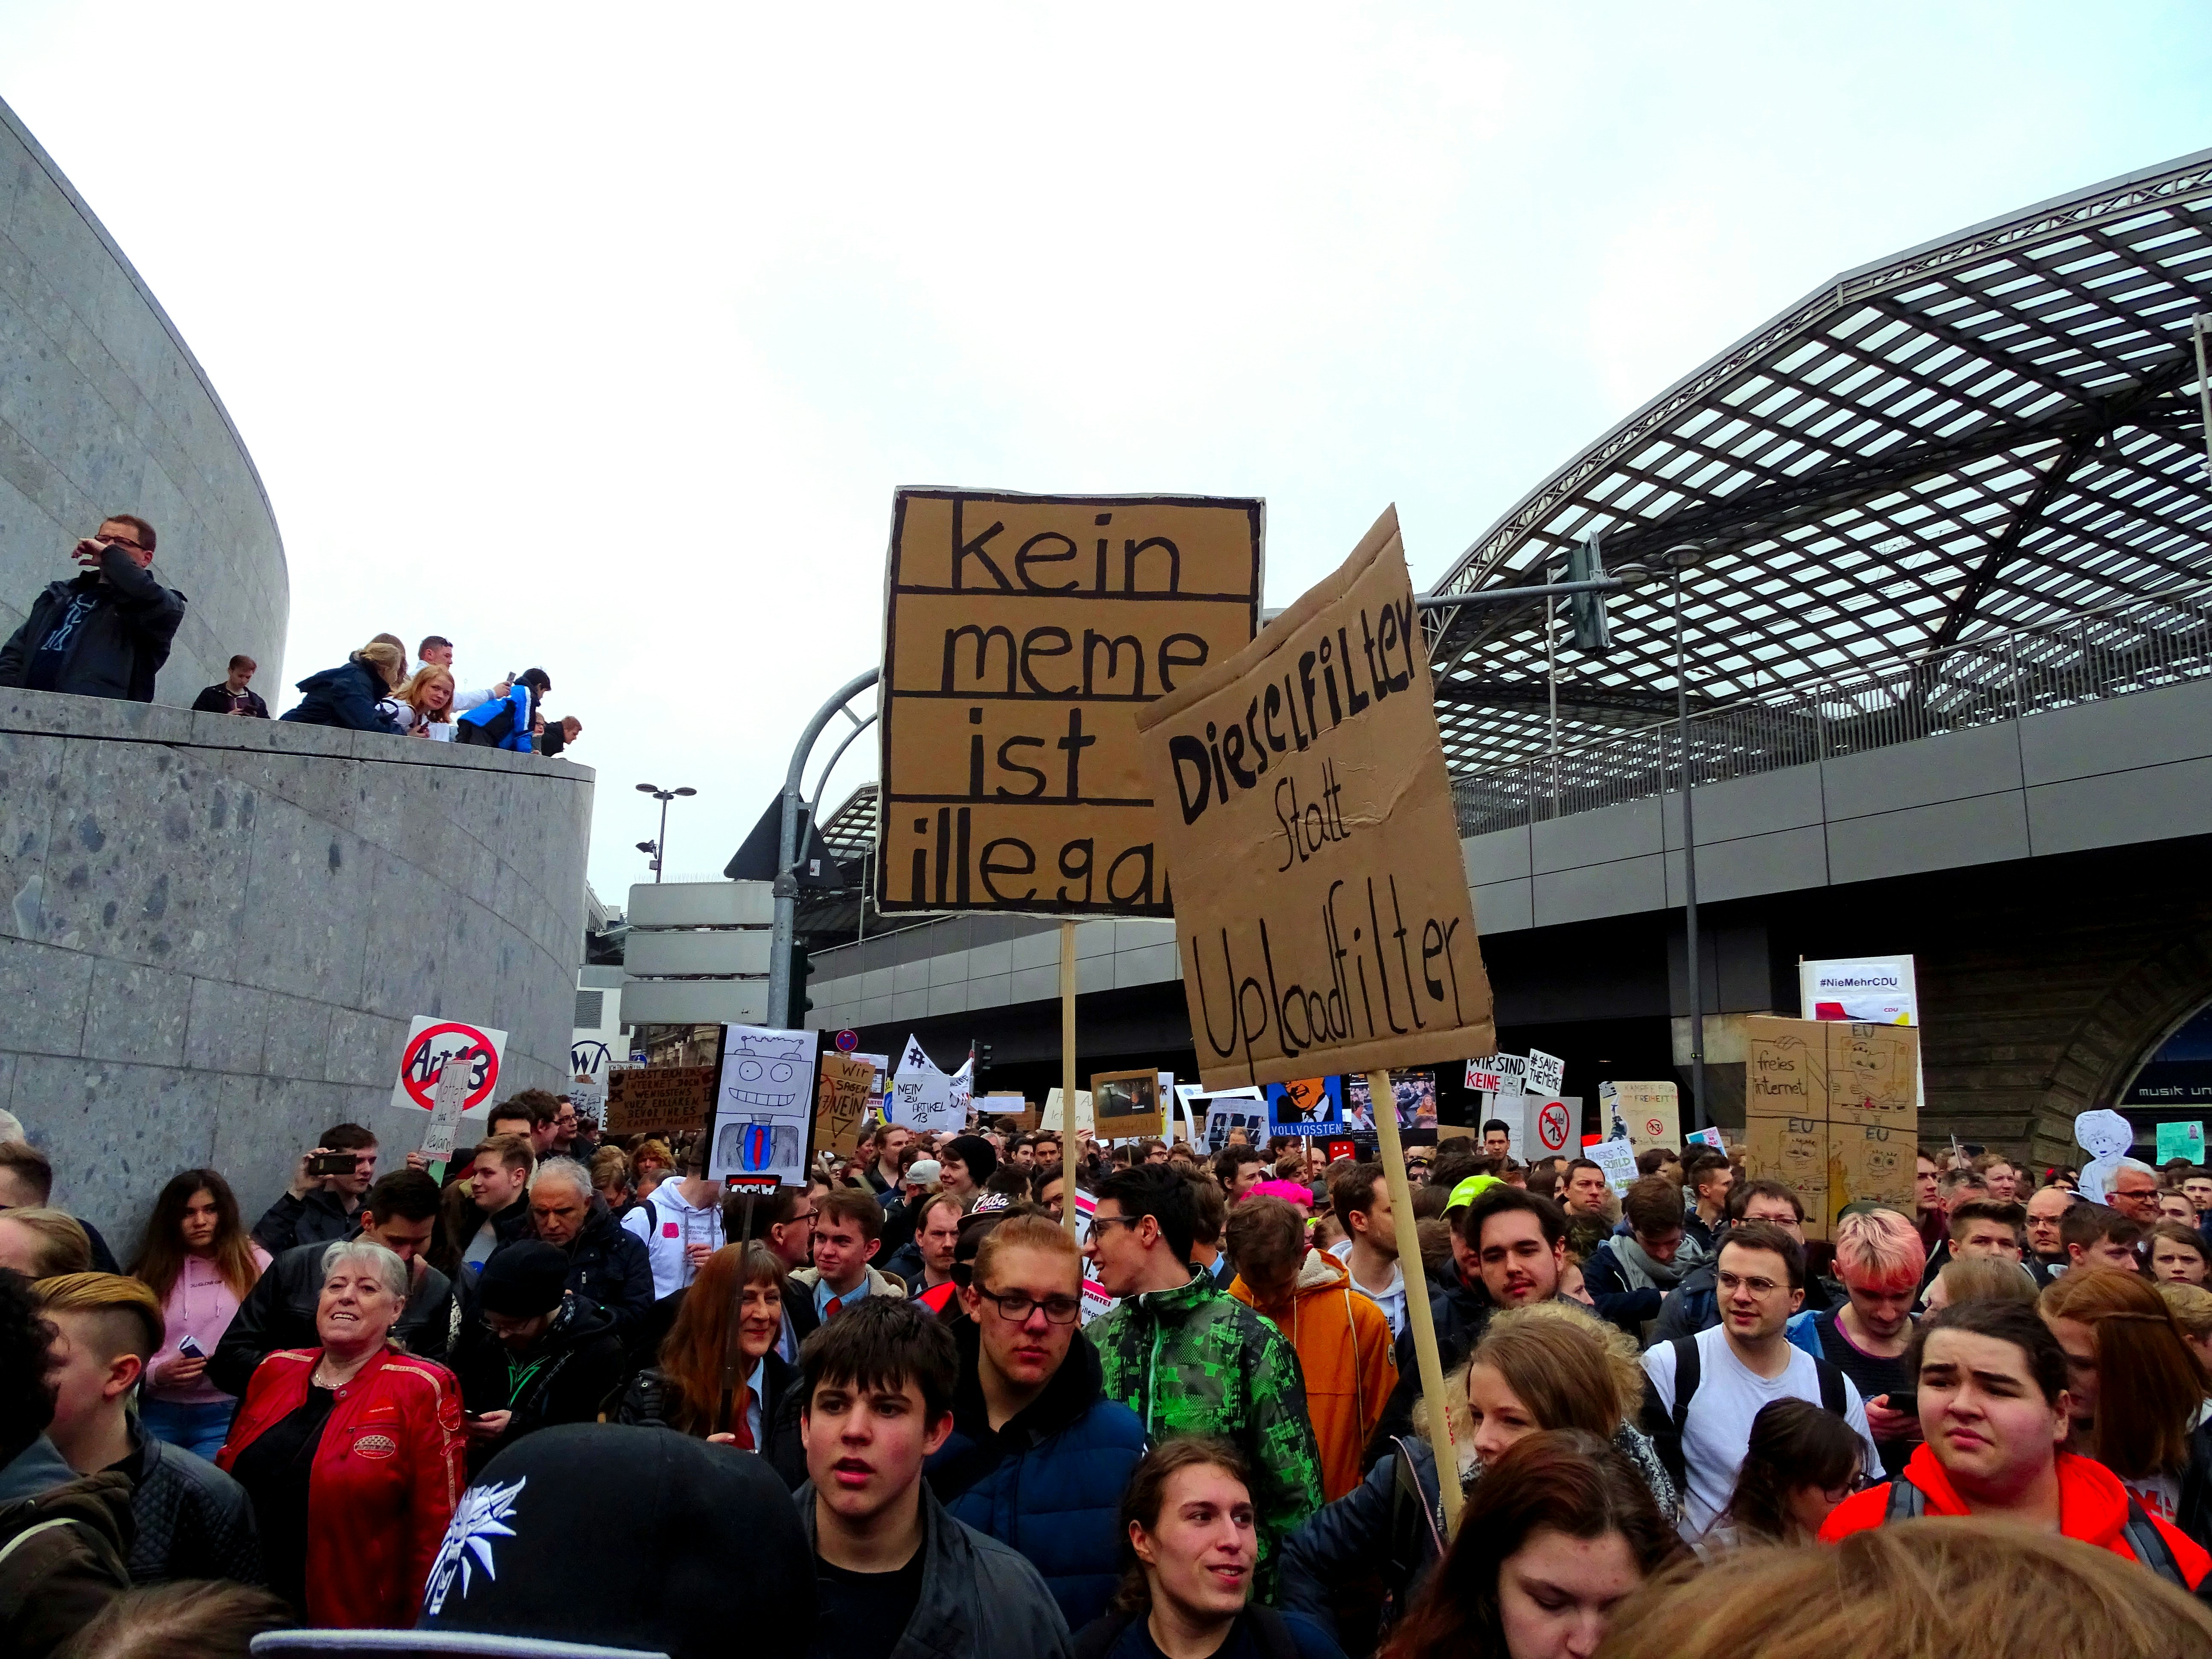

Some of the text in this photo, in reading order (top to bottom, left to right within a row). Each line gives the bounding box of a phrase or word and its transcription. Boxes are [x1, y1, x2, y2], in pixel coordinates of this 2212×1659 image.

[952, 498, 1179, 592] kein
[941, 625, 1208, 696] meme
[969, 708, 1096, 798] ist
[912, 807, 1173, 906] illega
[1193, 874, 1459, 1084] Uploadfilter
[1820, 977, 1898, 987] #NieMehrCDU
[1852, 1024, 1874, 1038] EU
[1470, 1056, 1525, 1076] WIR SIND
[1757, 1050, 1795, 1071] freies
[628, 1069, 661, 1080] LASST
[684, 1068, 702, 1077] DAS
[1467, 1070, 1501, 1091] KEINE
[626, 1078, 699, 1090] INTERNET DOCH
[836, 1080, 868, 1094] SAGEN
[898, 1083, 923, 1096] NEIN
[1755, 1076, 1806, 1095] internet
[2139, 1086, 2184, 1096] musik
[635, 1087, 692, 1099] WENIGSTENS
[663, 1108, 679, 1117] IHR
[683, 1106, 696, 1115] ES
[913, 1102, 946, 1113] ARTIKEL
[627, 1118, 662, 1128] KAPUTT
[912, 1112, 928, 1123] 13
[1271, 1123, 1342, 1136] VOLLVOSSTEN
[1789, 1119, 1814, 1133] EU
[1866, 1127, 1889, 1141] EU
[972, 1193, 1010, 1213] Cuba
[1084, 1290, 1111, 1307] PARTEI
